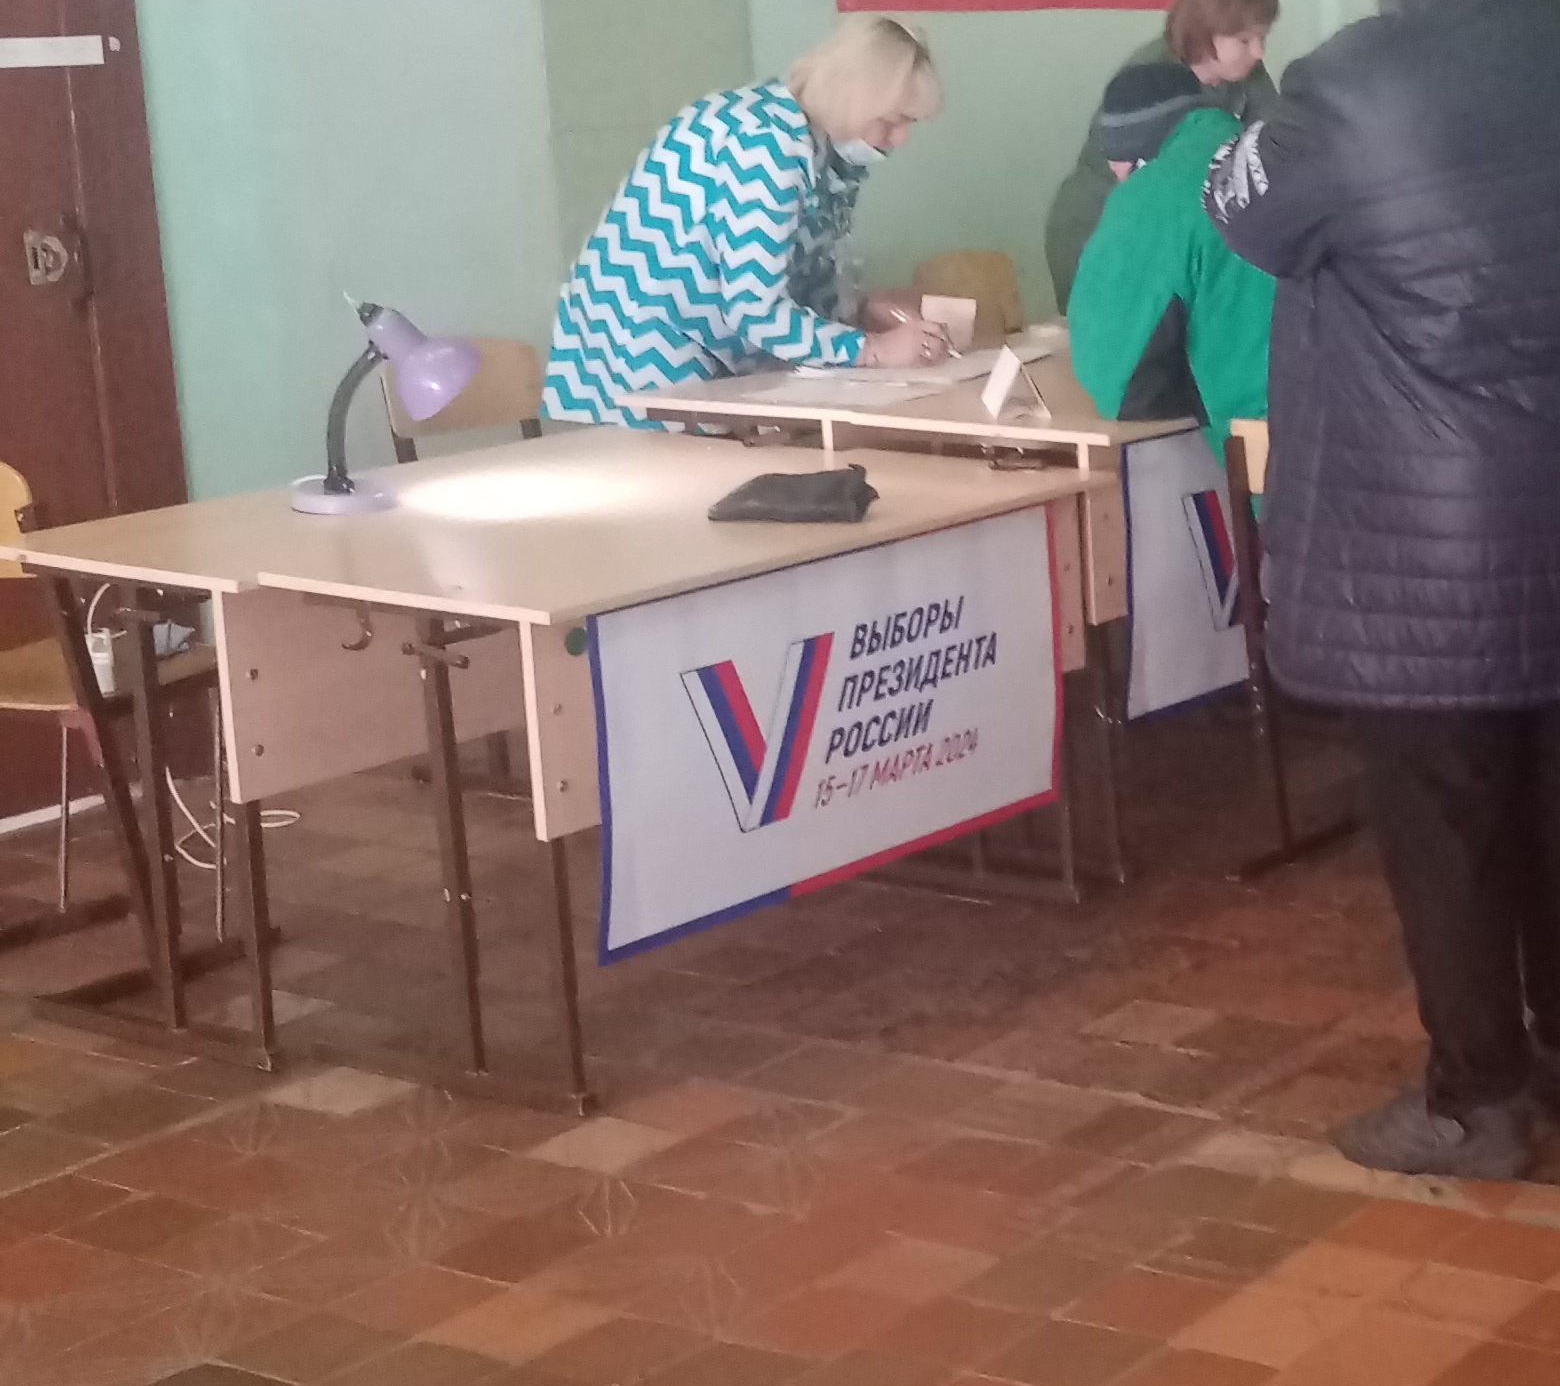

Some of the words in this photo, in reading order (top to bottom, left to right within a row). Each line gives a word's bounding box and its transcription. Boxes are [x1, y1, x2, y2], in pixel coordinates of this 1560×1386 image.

[850, 595, 964, 661] ВЫБОРЫ
[838, 631, 997, 712] ПРЕЗИДЕНТА
[825, 699, 934, 764] РОССИИ
[869, 742, 934, 790] МАРТА
